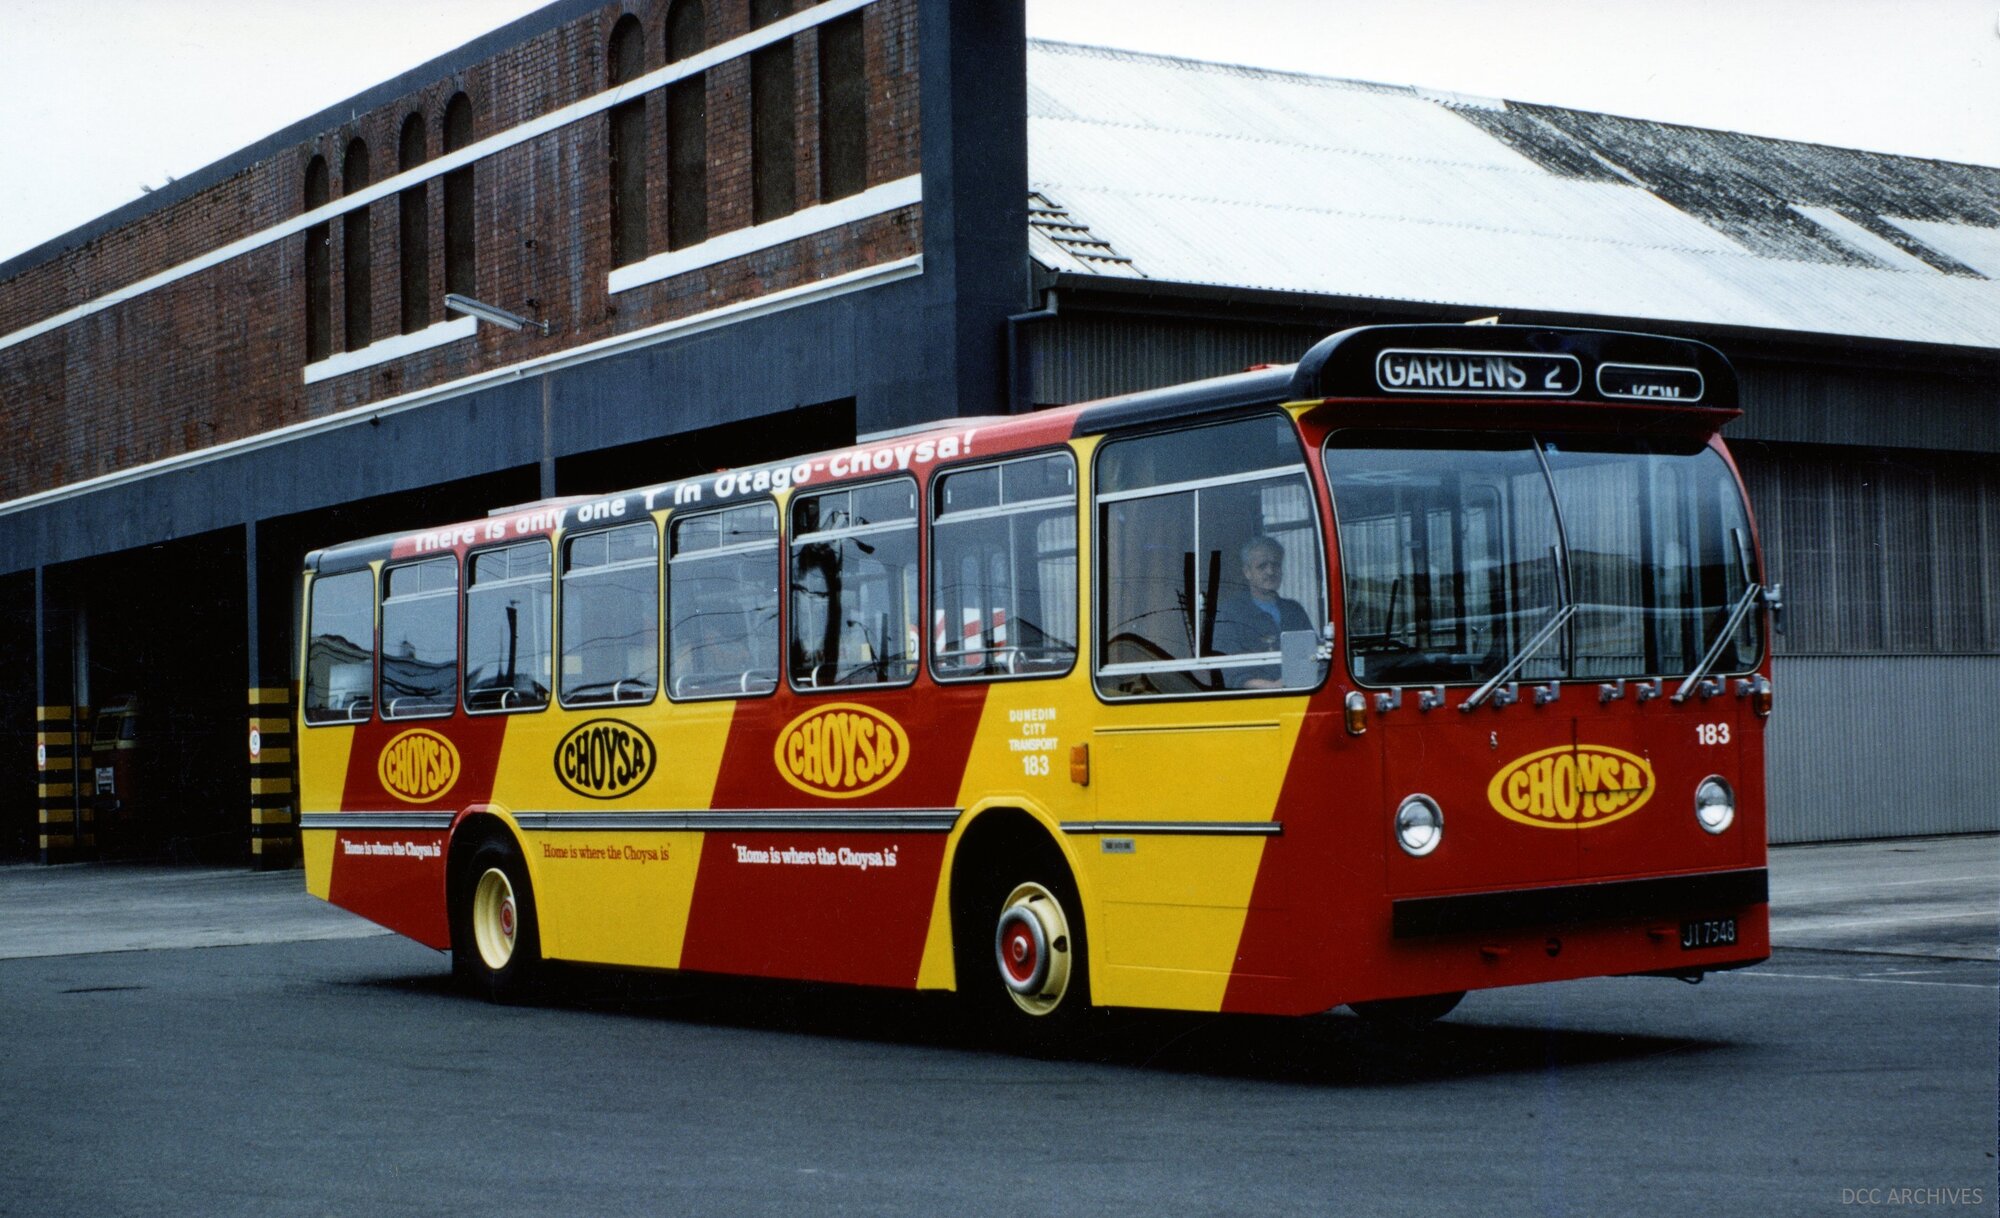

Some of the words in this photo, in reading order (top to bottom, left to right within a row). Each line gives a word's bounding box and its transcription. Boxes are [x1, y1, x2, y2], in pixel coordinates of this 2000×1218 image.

[1384, 356, 1527, 389] GARDENS
[1545, 360, 1563, 389] 2
[416, 526, 475, 552] There
[485, 520, 505, 540] is
[516, 509, 567, 534] only
[578, 498, 626, 522] one
[674, 482, 701, 505] in
[1008, 707, 1056, 722] DUNEDIN
[1022, 723, 1046, 736] CITY
[1695, 723, 1730, 745] 183
[788, 712, 895, 788] CHOYSA
[1008, 737, 1058, 751] TRANSPORT
[388, 735, 451, 795] CHOYSA
[564, 726, 646, 790] CHOYSA
[1022, 755, 1049, 776] 183
[1508, 753, 1642, 820] CHOYSA
[364, 841, 372, 855] is
[393, 841, 405, 856] the
[405, 842, 433, 860] Choysa
[570, 844, 578, 858] is
[578, 844, 605, 859] where
[606, 845, 622, 859] the
[623, 845, 658, 864] Choysa
[769, 846, 781, 864] is
[781, 846, 817, 865] where
[817, 847, 837, 865] the
[838, 848, 883, 871] Choysa
